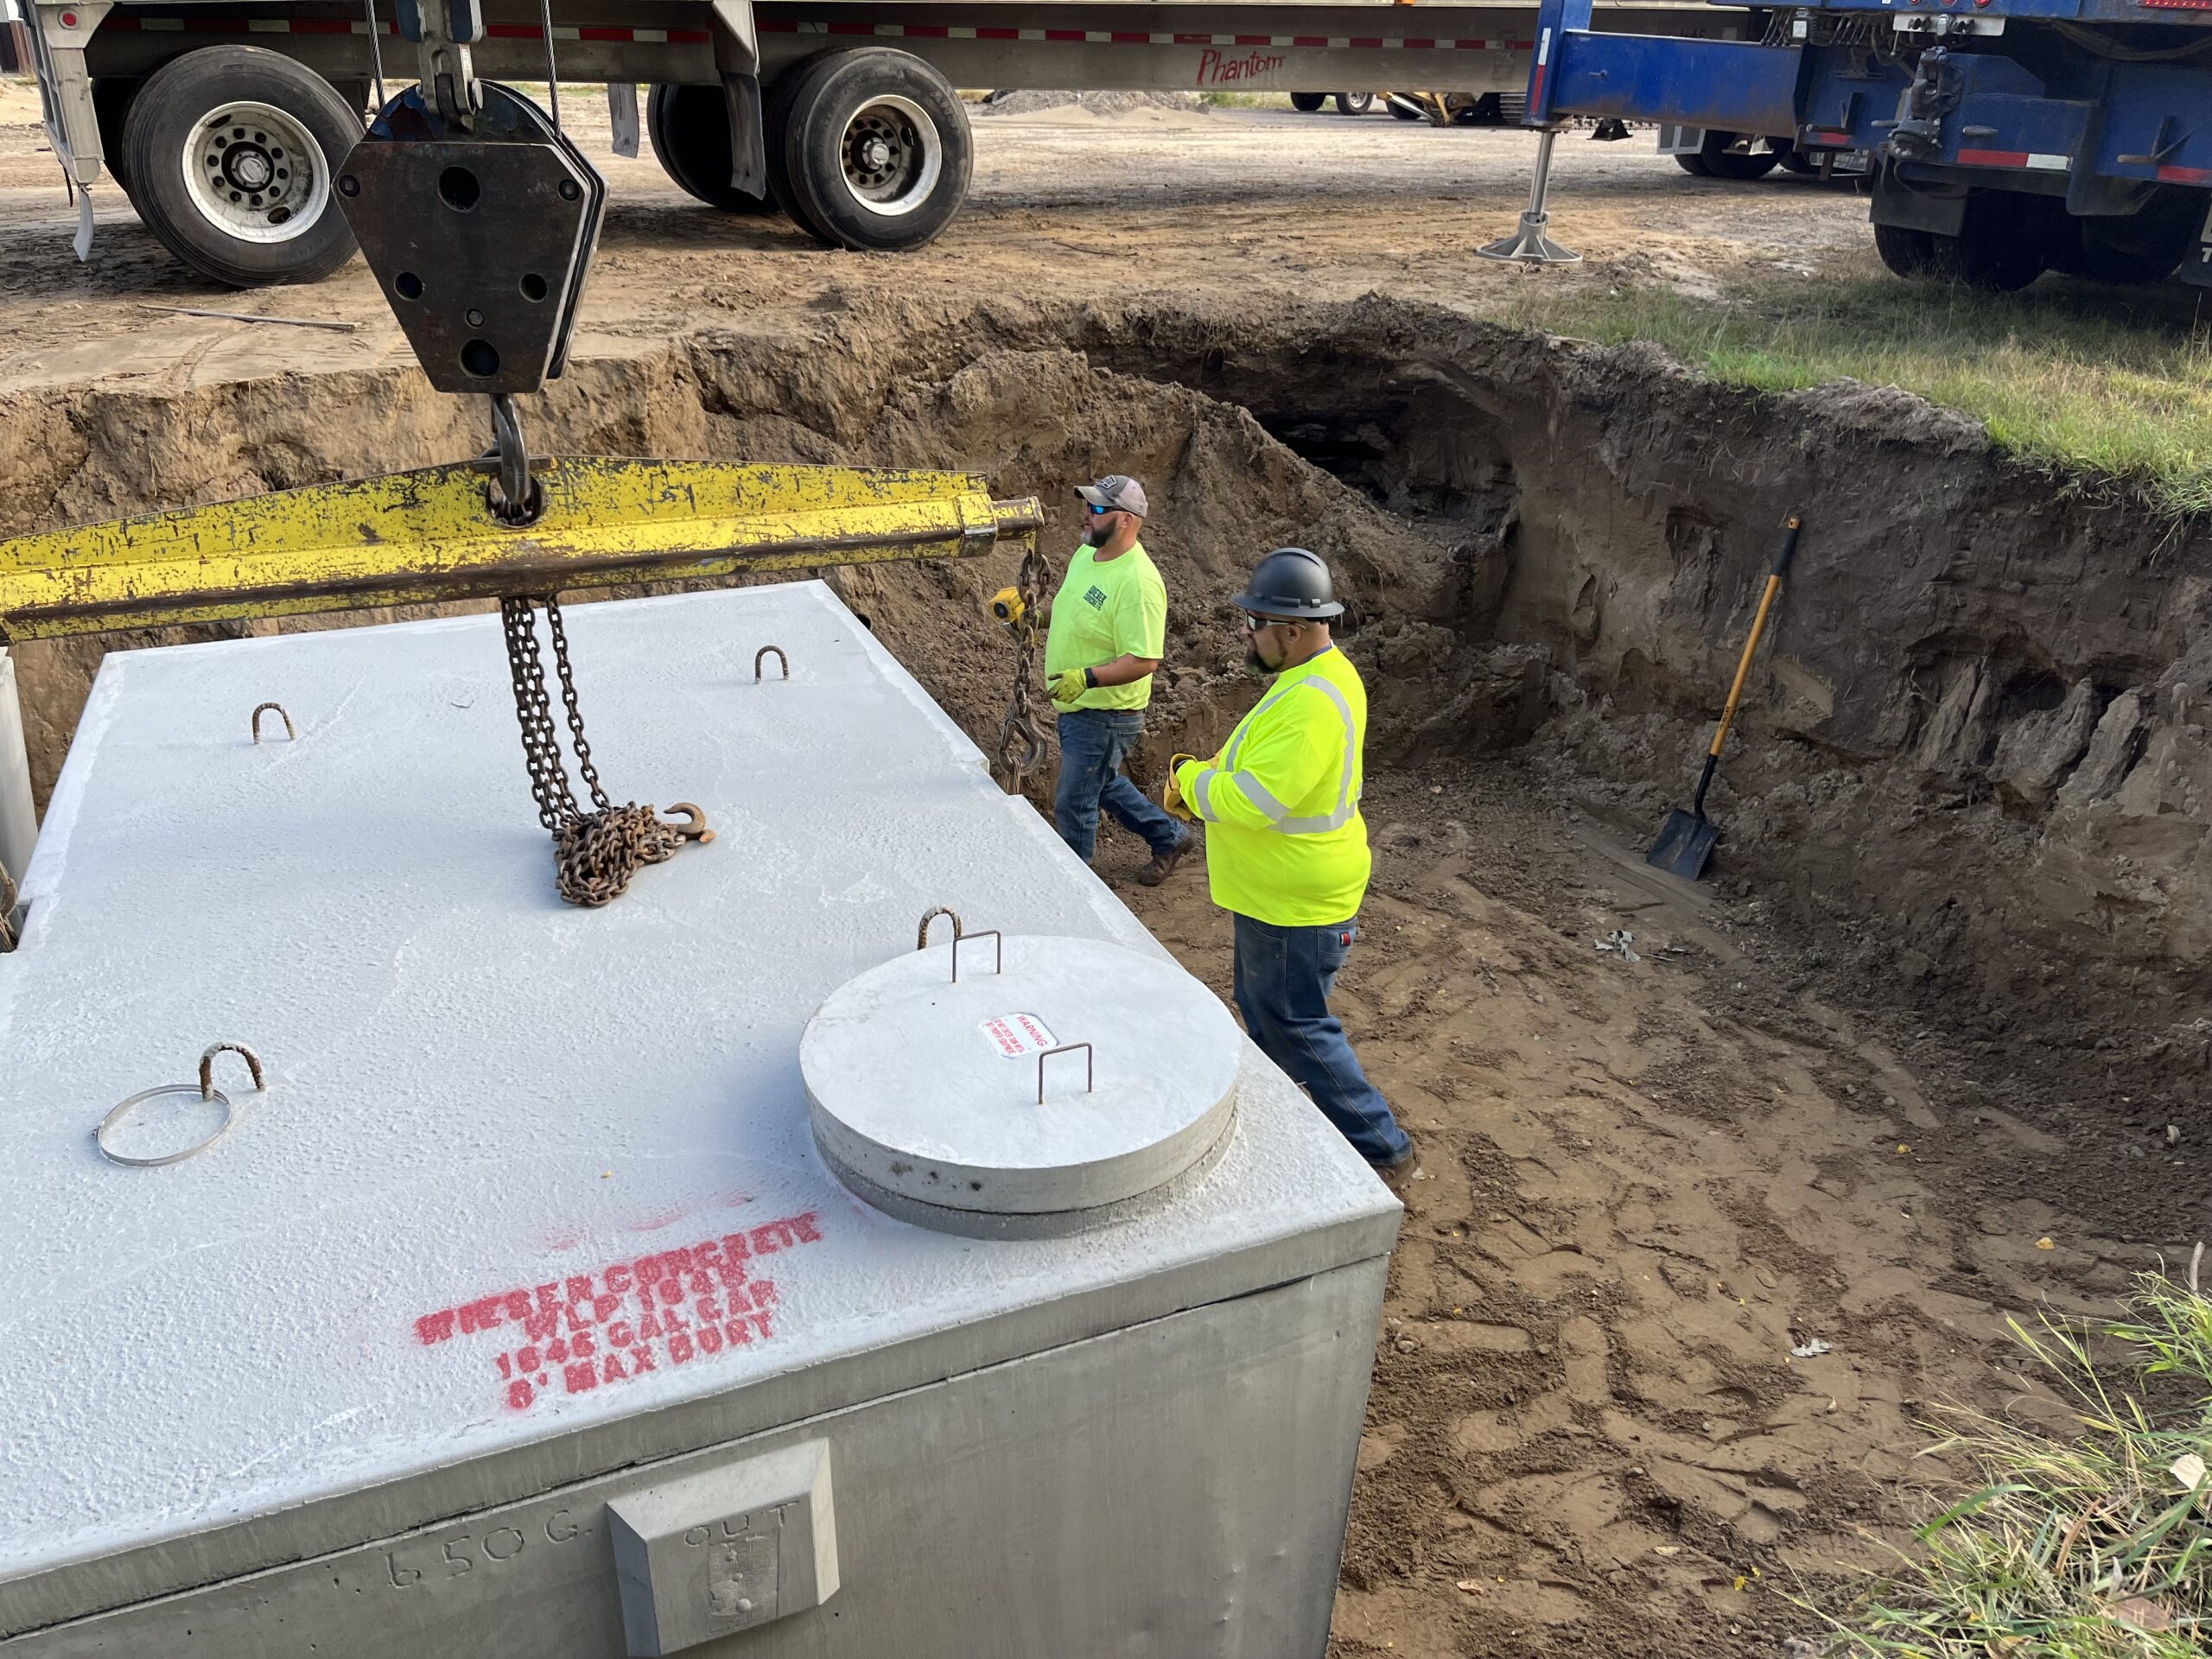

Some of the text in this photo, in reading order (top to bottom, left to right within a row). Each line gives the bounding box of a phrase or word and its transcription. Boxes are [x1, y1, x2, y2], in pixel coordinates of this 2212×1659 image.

[1197, 49, 1283, 85] Phantom
[1017, 1015, 1047, 1046] WARNING
[605, 1212, 823, 1293] CONCRETE
[524, 1294, 622, 1341] WLP
[607, 1309, 690, 1348] GAL
[696, 1281, 779, 1322] CAP
[564, 1345, 657, 1394] MAX
[684, 1500, 800, 1547] OUT
